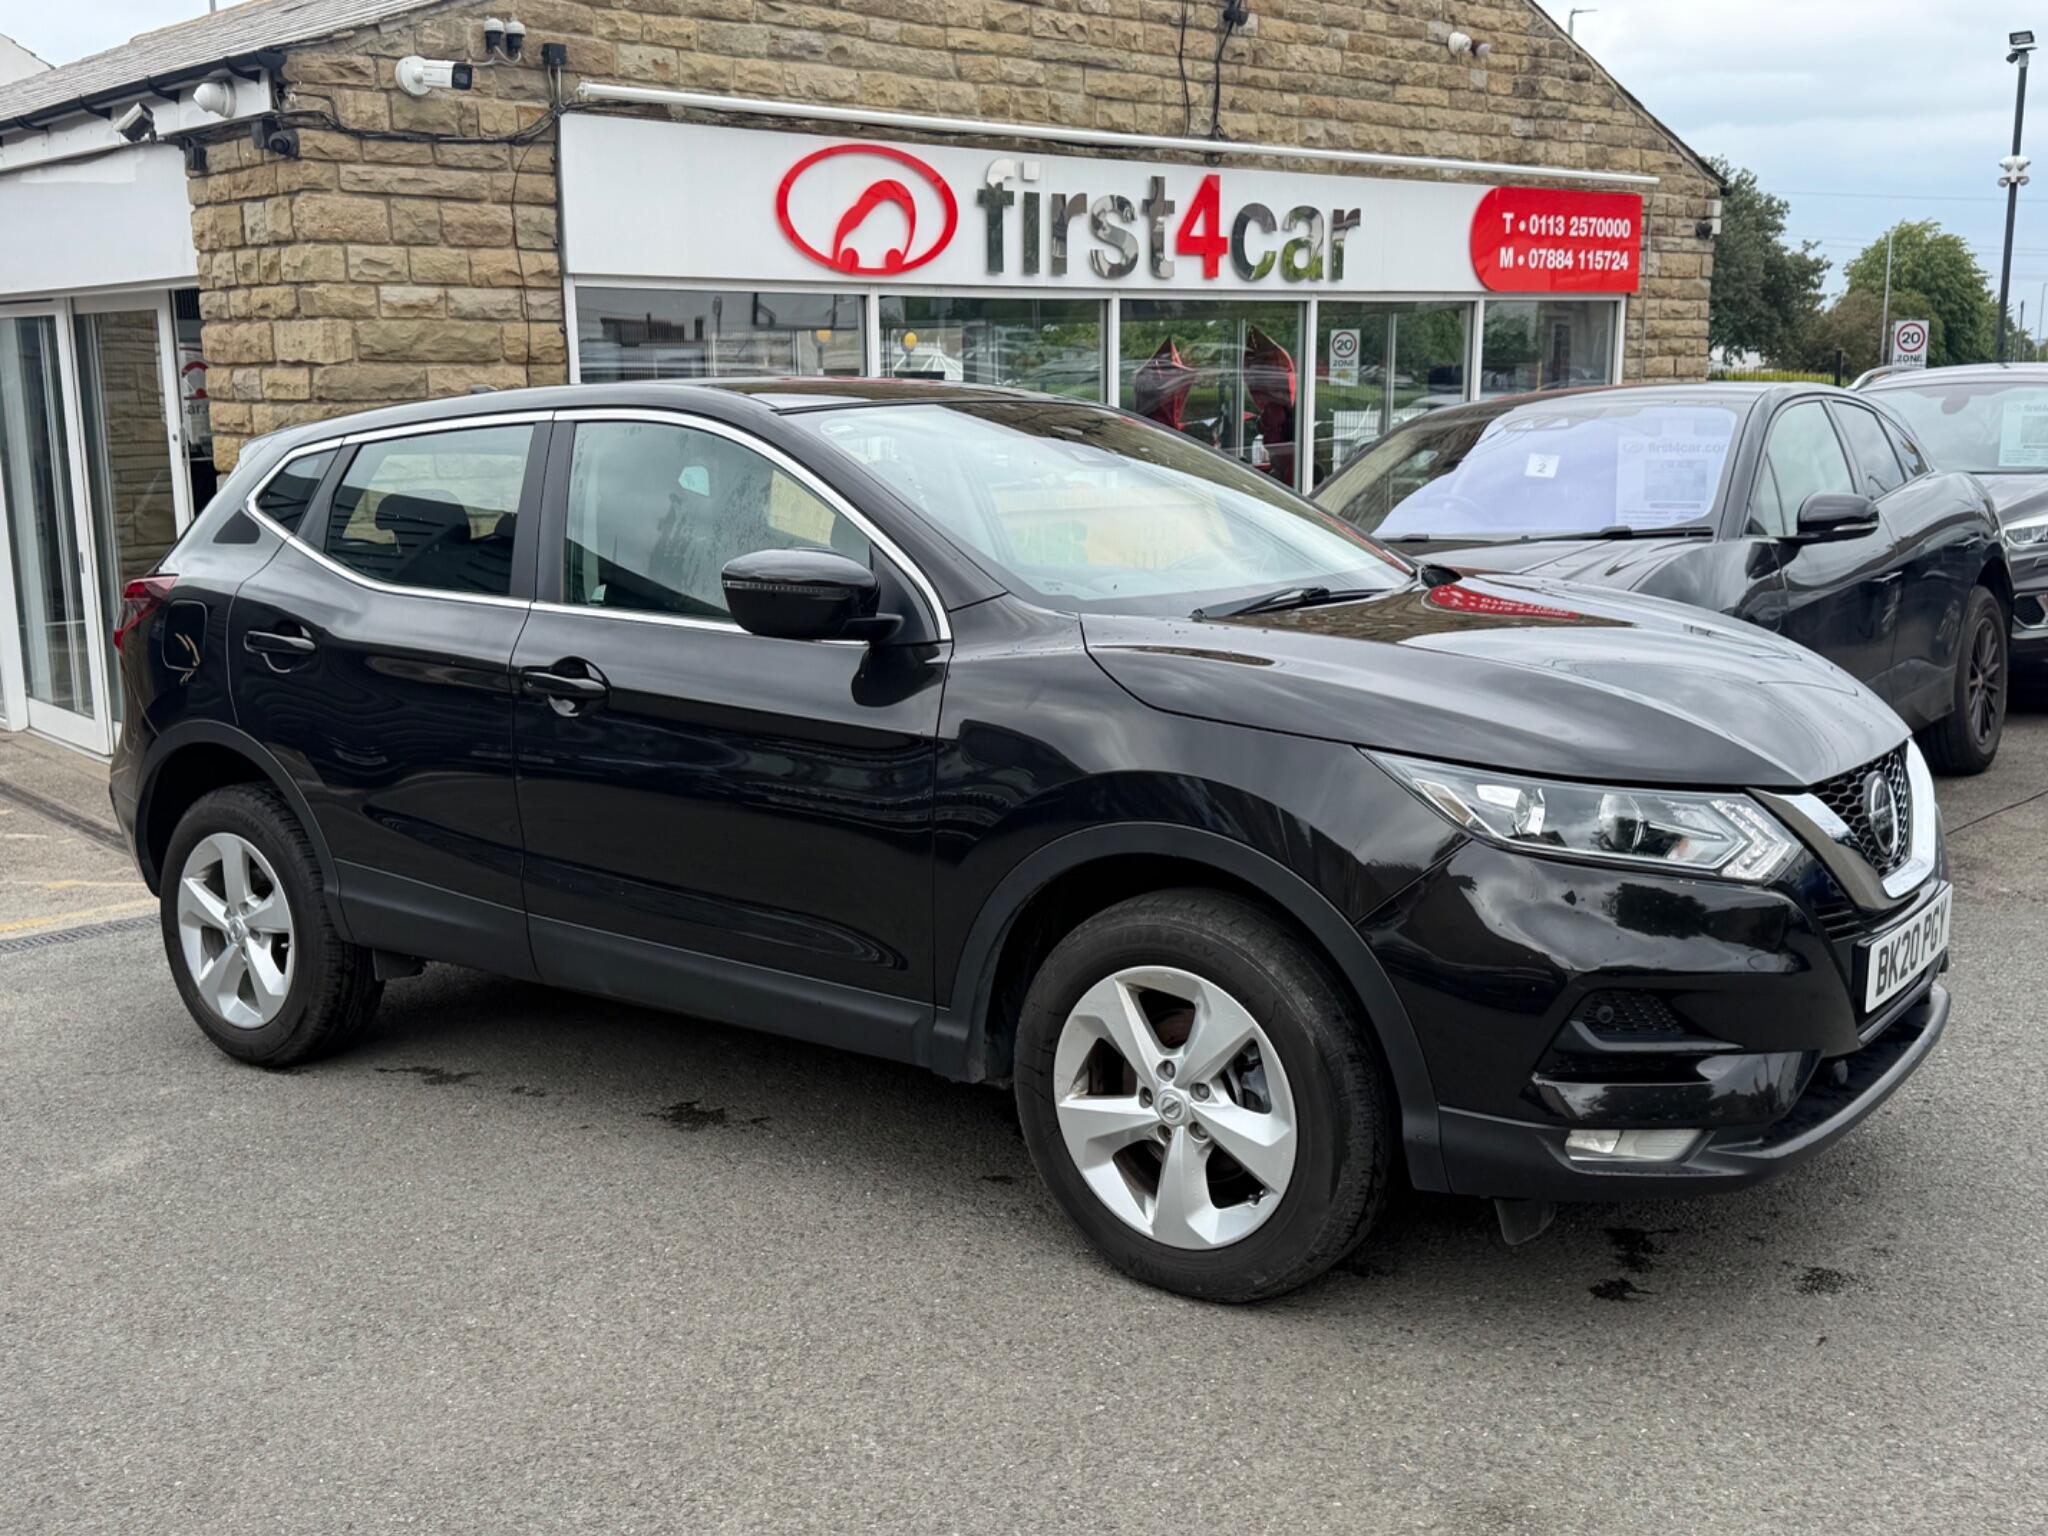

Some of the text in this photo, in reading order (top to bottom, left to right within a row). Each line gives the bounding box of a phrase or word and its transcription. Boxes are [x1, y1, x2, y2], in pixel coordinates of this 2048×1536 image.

[977, 158, 1361, 282] first4car
[1502, 212, 1631, 239] T 0113 2570000
[1500, 247, 1629, 271] M 07884 115724
[1336, 339, 1353, 351] 20
[1902, 331, 1921, 344] 20
[1333, 359, 1355, 368] ZONE
[1897, 353, 1922, 363] ZONE
[1876, 898, 1948, 997] BK20 PGY
